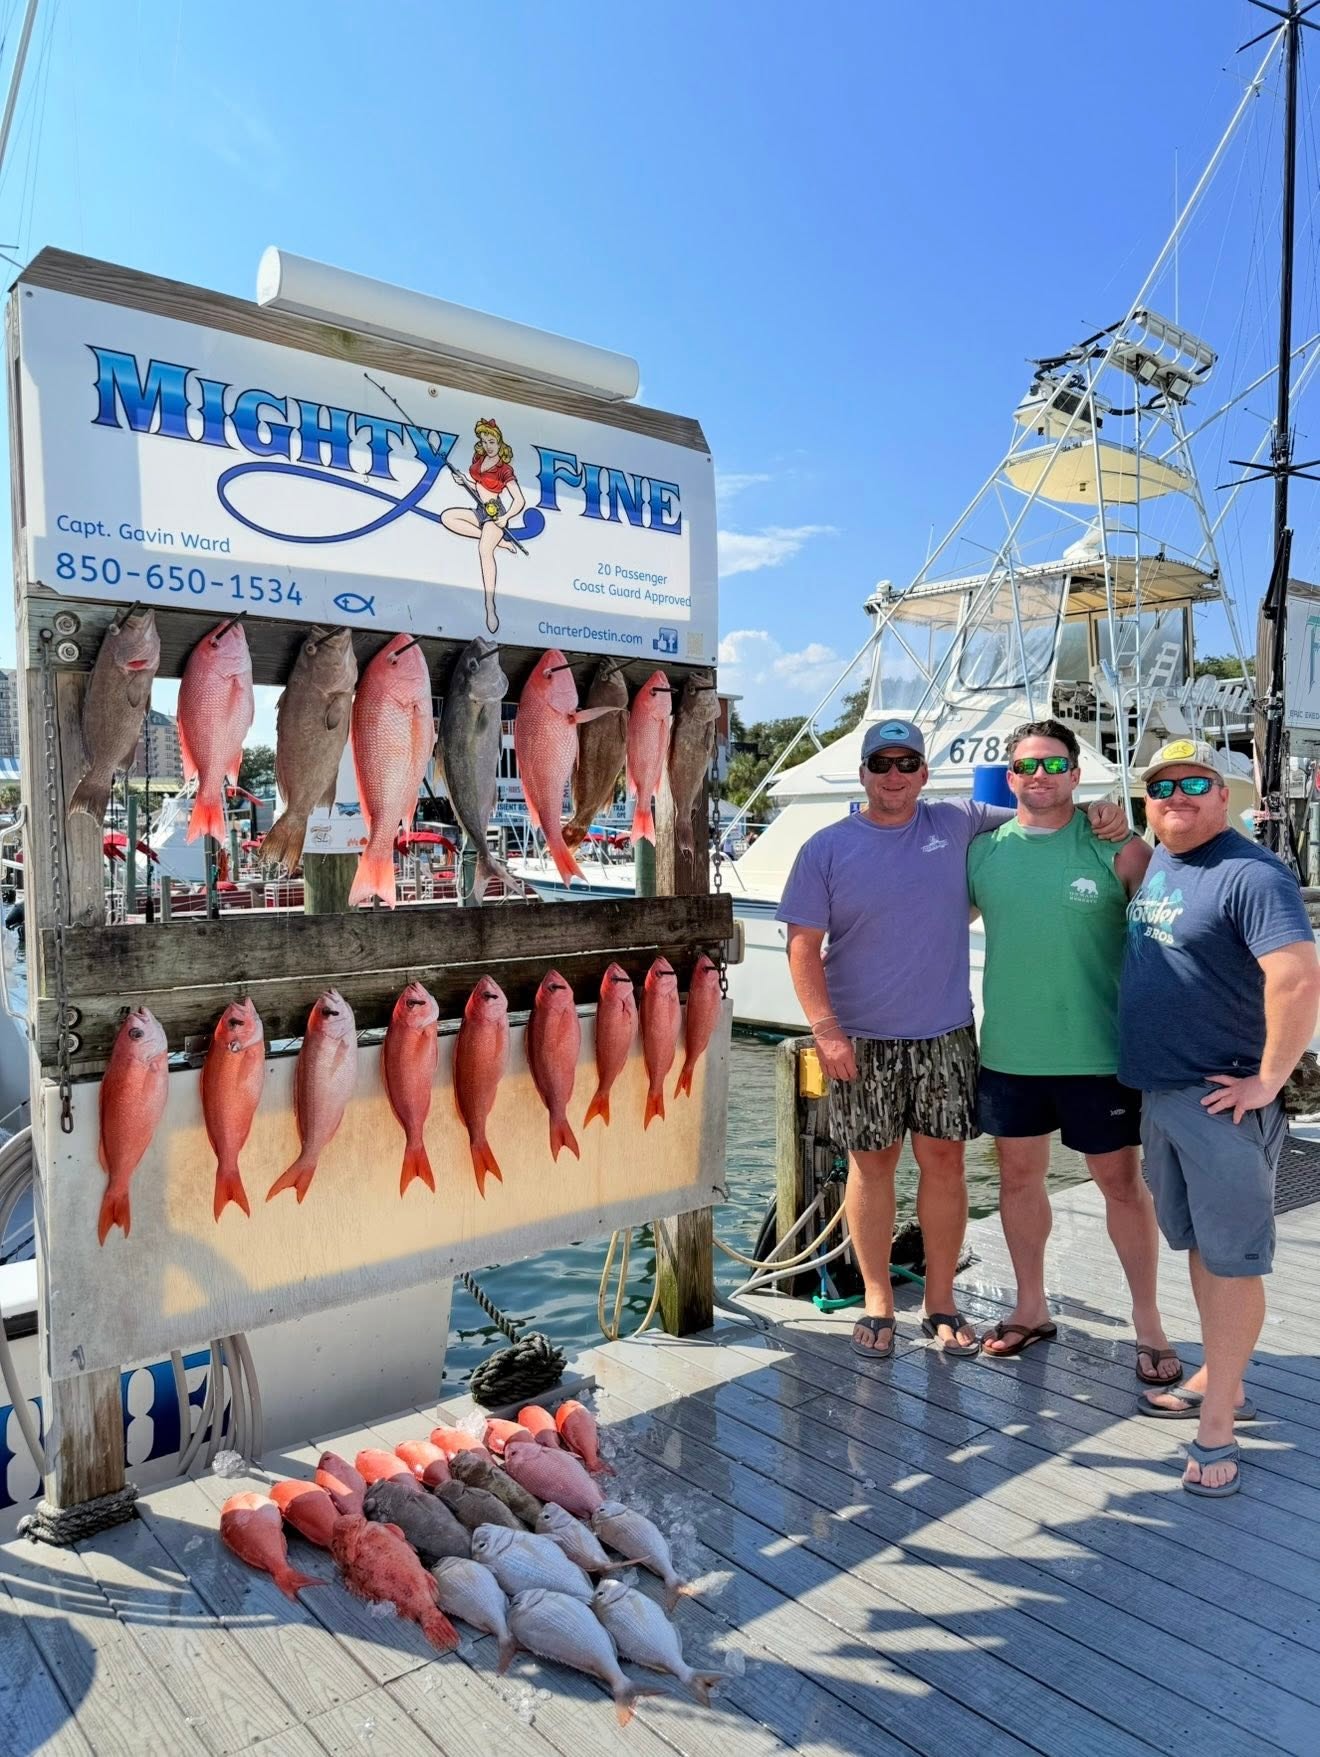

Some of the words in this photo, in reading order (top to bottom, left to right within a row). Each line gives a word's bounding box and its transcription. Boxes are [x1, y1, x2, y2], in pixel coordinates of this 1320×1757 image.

[85, 344, 459, 483] MIGHTY
[531, 445, 682, 535] FINE
[57, 515, 111, 538] Capt.
[119, 523, 174, 546] Gavin
[181, 530, 231, 553] Ward
[56, 552, 303, 606] 850-650-1534
[597, 563, 611, 576] 20
[615, 565, 668, 586] Passenger
[573, 578, 605, 594] Coast
[608, 584, 641, 599] Guard
[645, 589, 692, 607] Approved
[538, 621, 643, 646] CharterDestin.com
[1144, 926, 1175, 944] BROS
